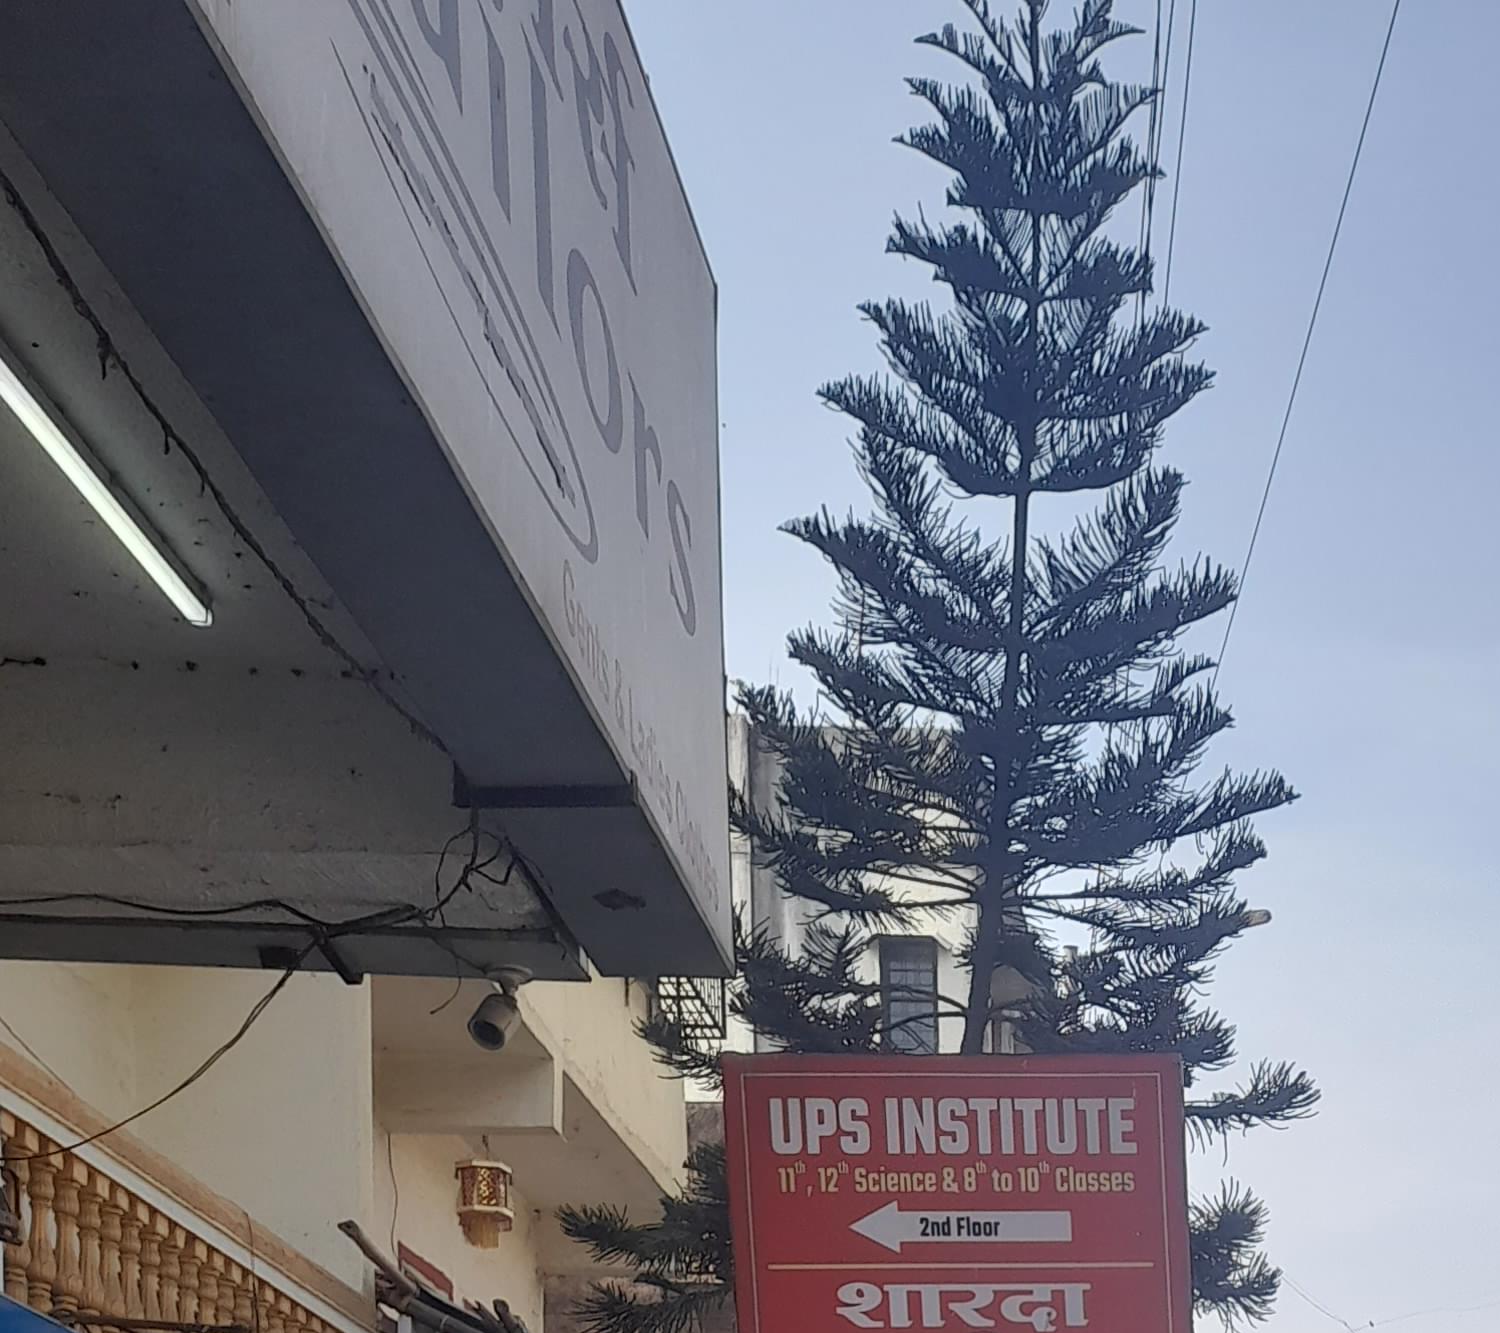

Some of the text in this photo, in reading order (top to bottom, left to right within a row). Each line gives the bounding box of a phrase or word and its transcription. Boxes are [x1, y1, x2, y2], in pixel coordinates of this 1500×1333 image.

[562, 558, 610, 704] Gents
[614, 657, 626, 731] &
[768, 1095, 1138, 1156] UPS INSTITUTE
[854, 1166, 937, 1193] Science
[942, 1168, 960, 1193] &
[992, 1170, 1013, 1193] to
[1055, 1166, 1136, 1193] Classes
[919, 1215, 1001, 1238] 2nd Floor
[835, 1281, 1092, 1333] शारदा
